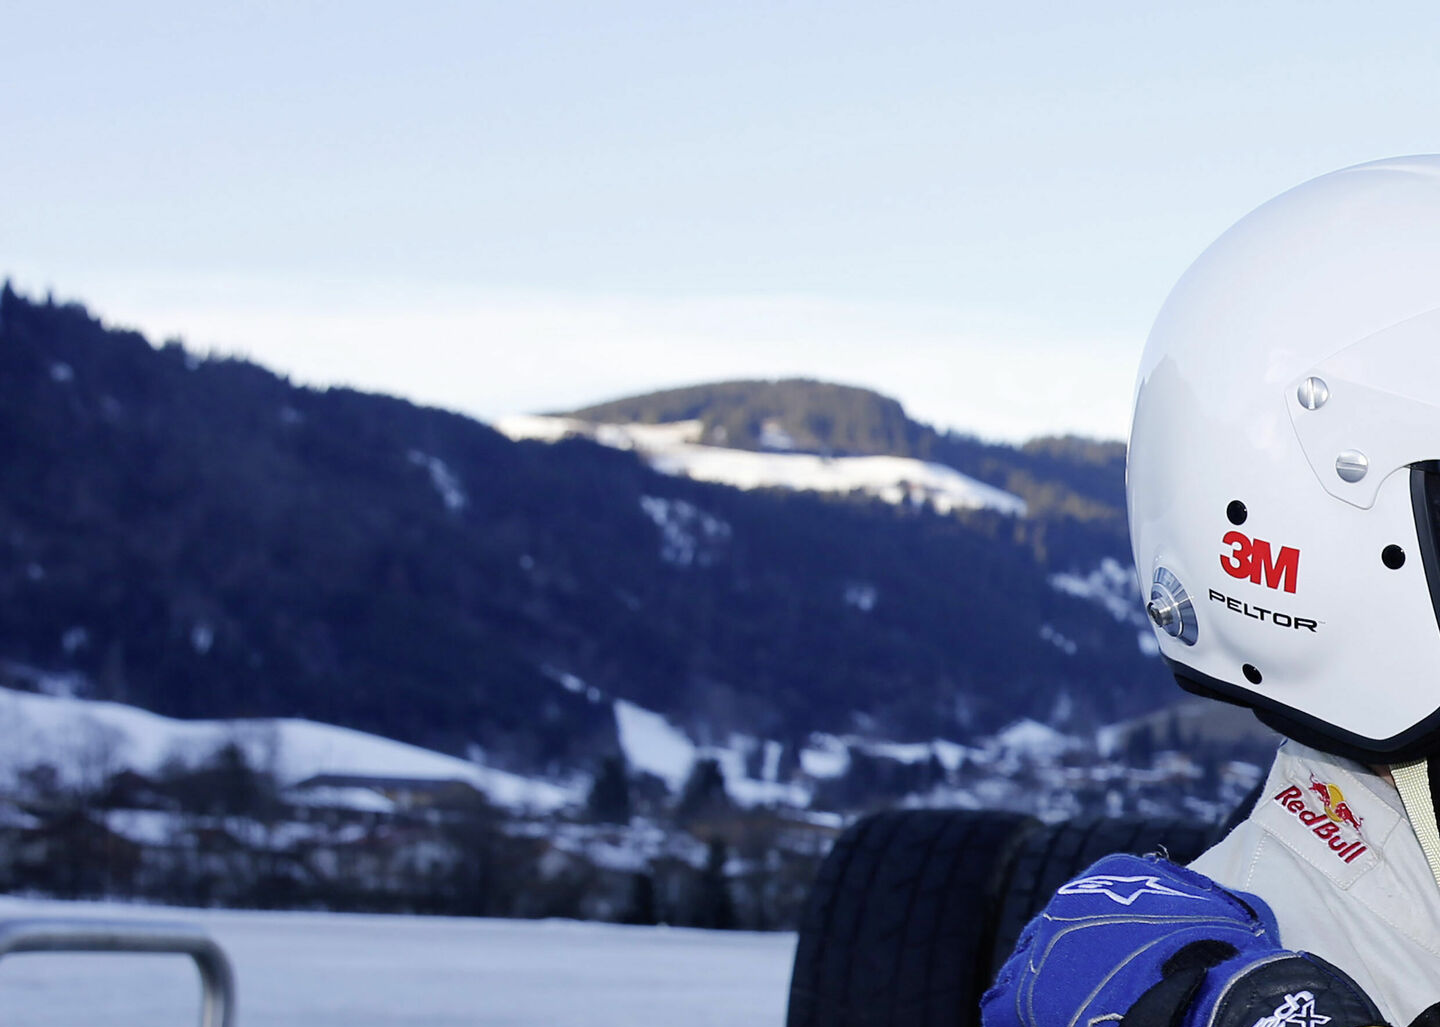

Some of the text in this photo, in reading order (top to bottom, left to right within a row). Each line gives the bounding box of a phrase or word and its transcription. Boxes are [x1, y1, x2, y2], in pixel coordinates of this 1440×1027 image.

[1219, 530, 1300, 594] 3M
[1208, 588, 1318, 633] PELTOR
[1273, 785, 1368, 864] Red Bull
